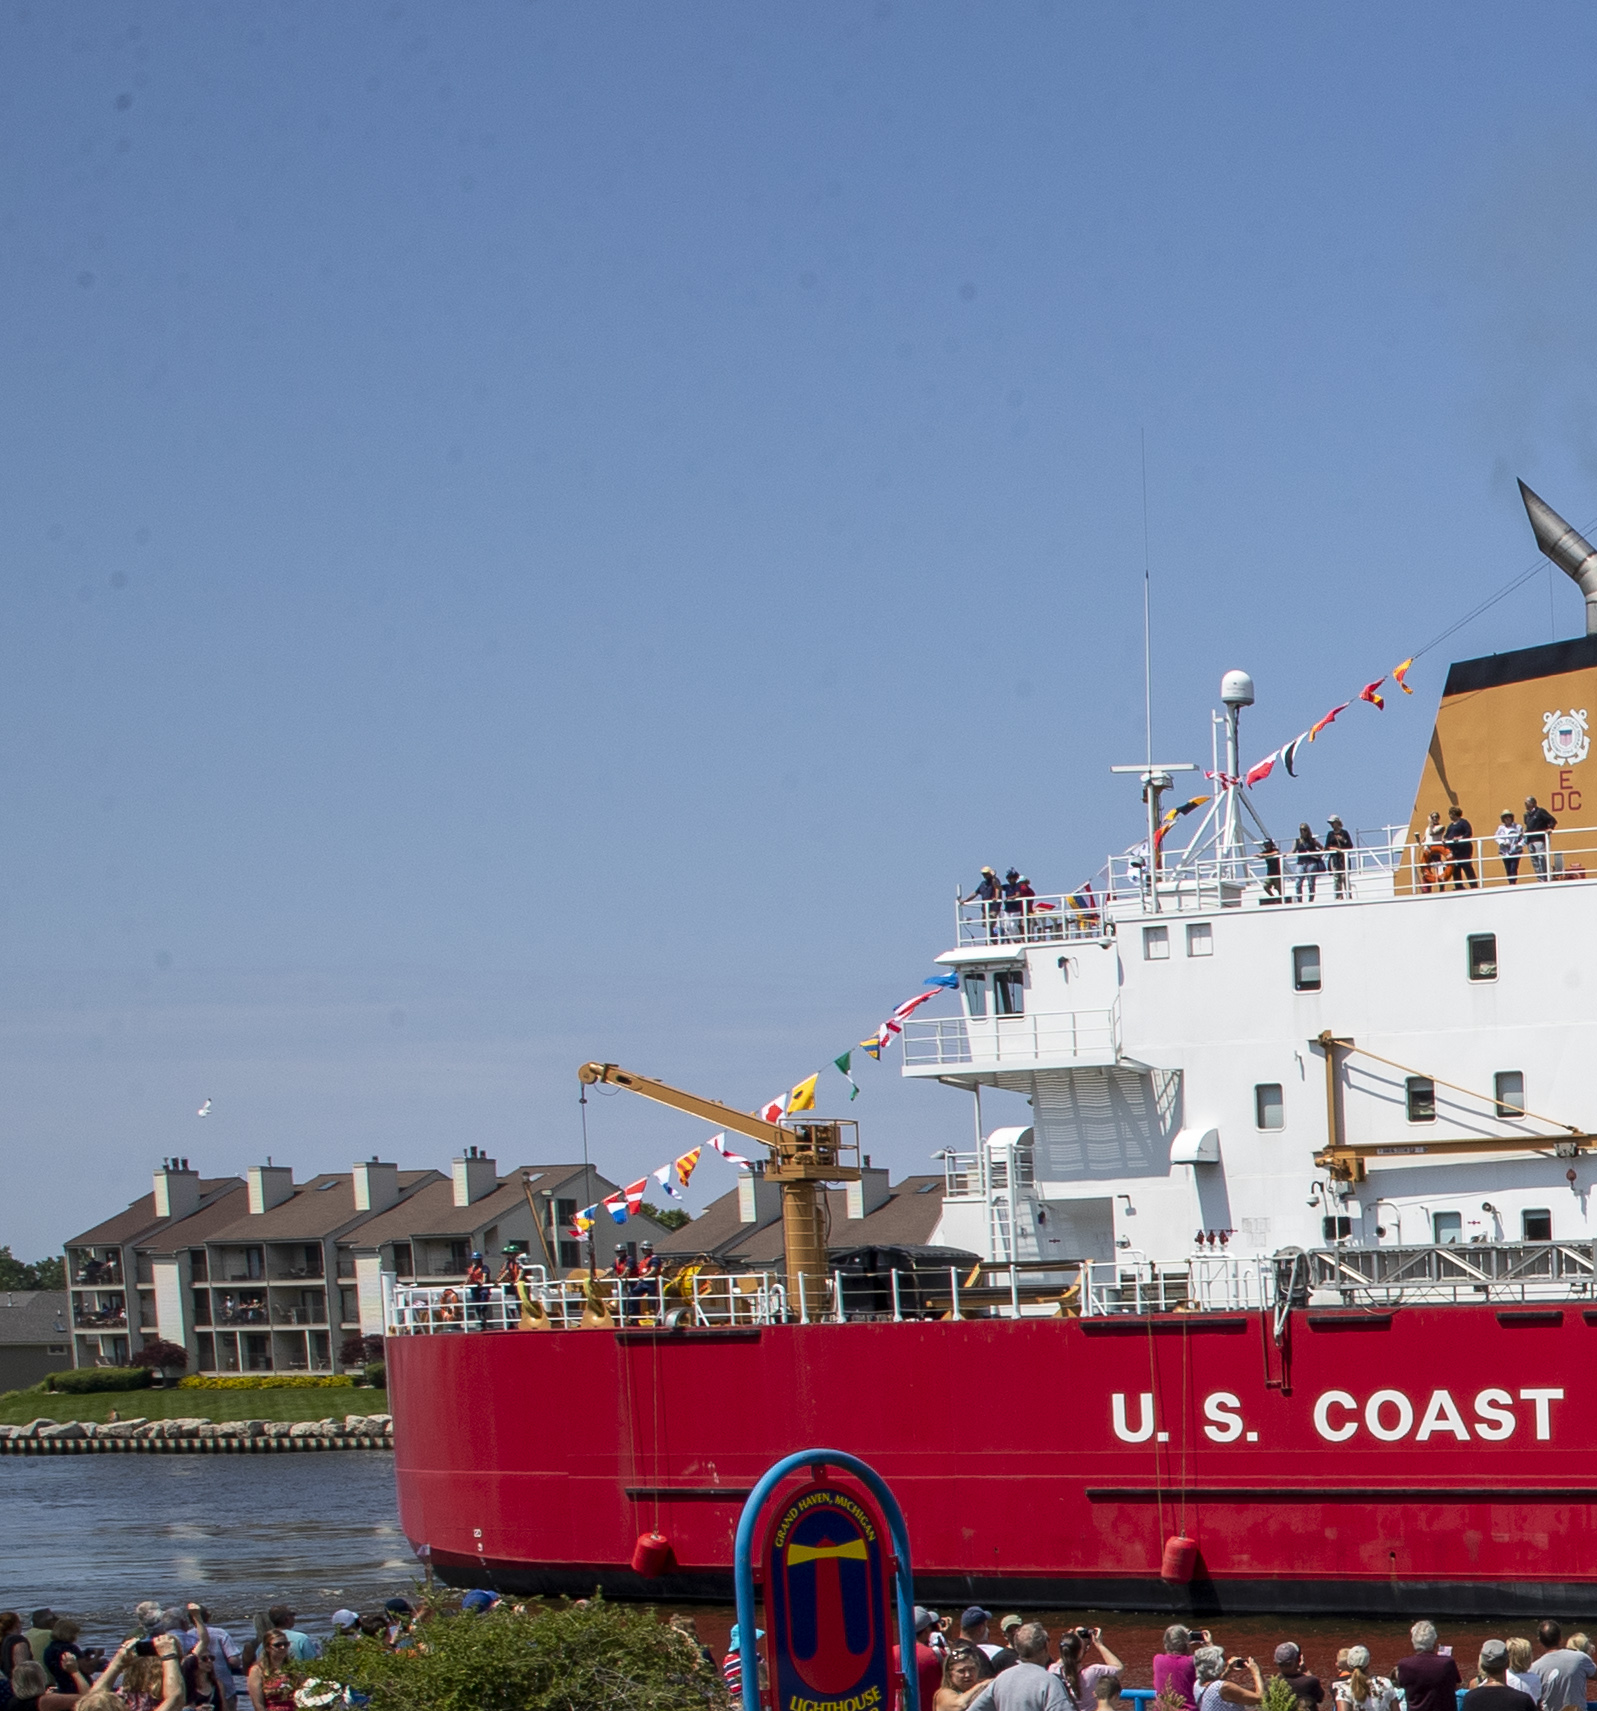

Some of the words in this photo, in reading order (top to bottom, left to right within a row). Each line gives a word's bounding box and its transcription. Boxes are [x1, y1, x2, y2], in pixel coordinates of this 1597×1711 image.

[1560, 770, 1573, 790] E
[1551, 791, 1582, 812] DC
[1112, 1393, 1169, 1442] U.
[1204, 1392, 1258, 1442] S.
[1314, 1389, 1564, 1441] COAST
[775, 1507, 799, 1548] GRAND
[799, 1492, 833, 1511] HAVEN,
[834, 1494, 876, 1542] MICHIGAN
